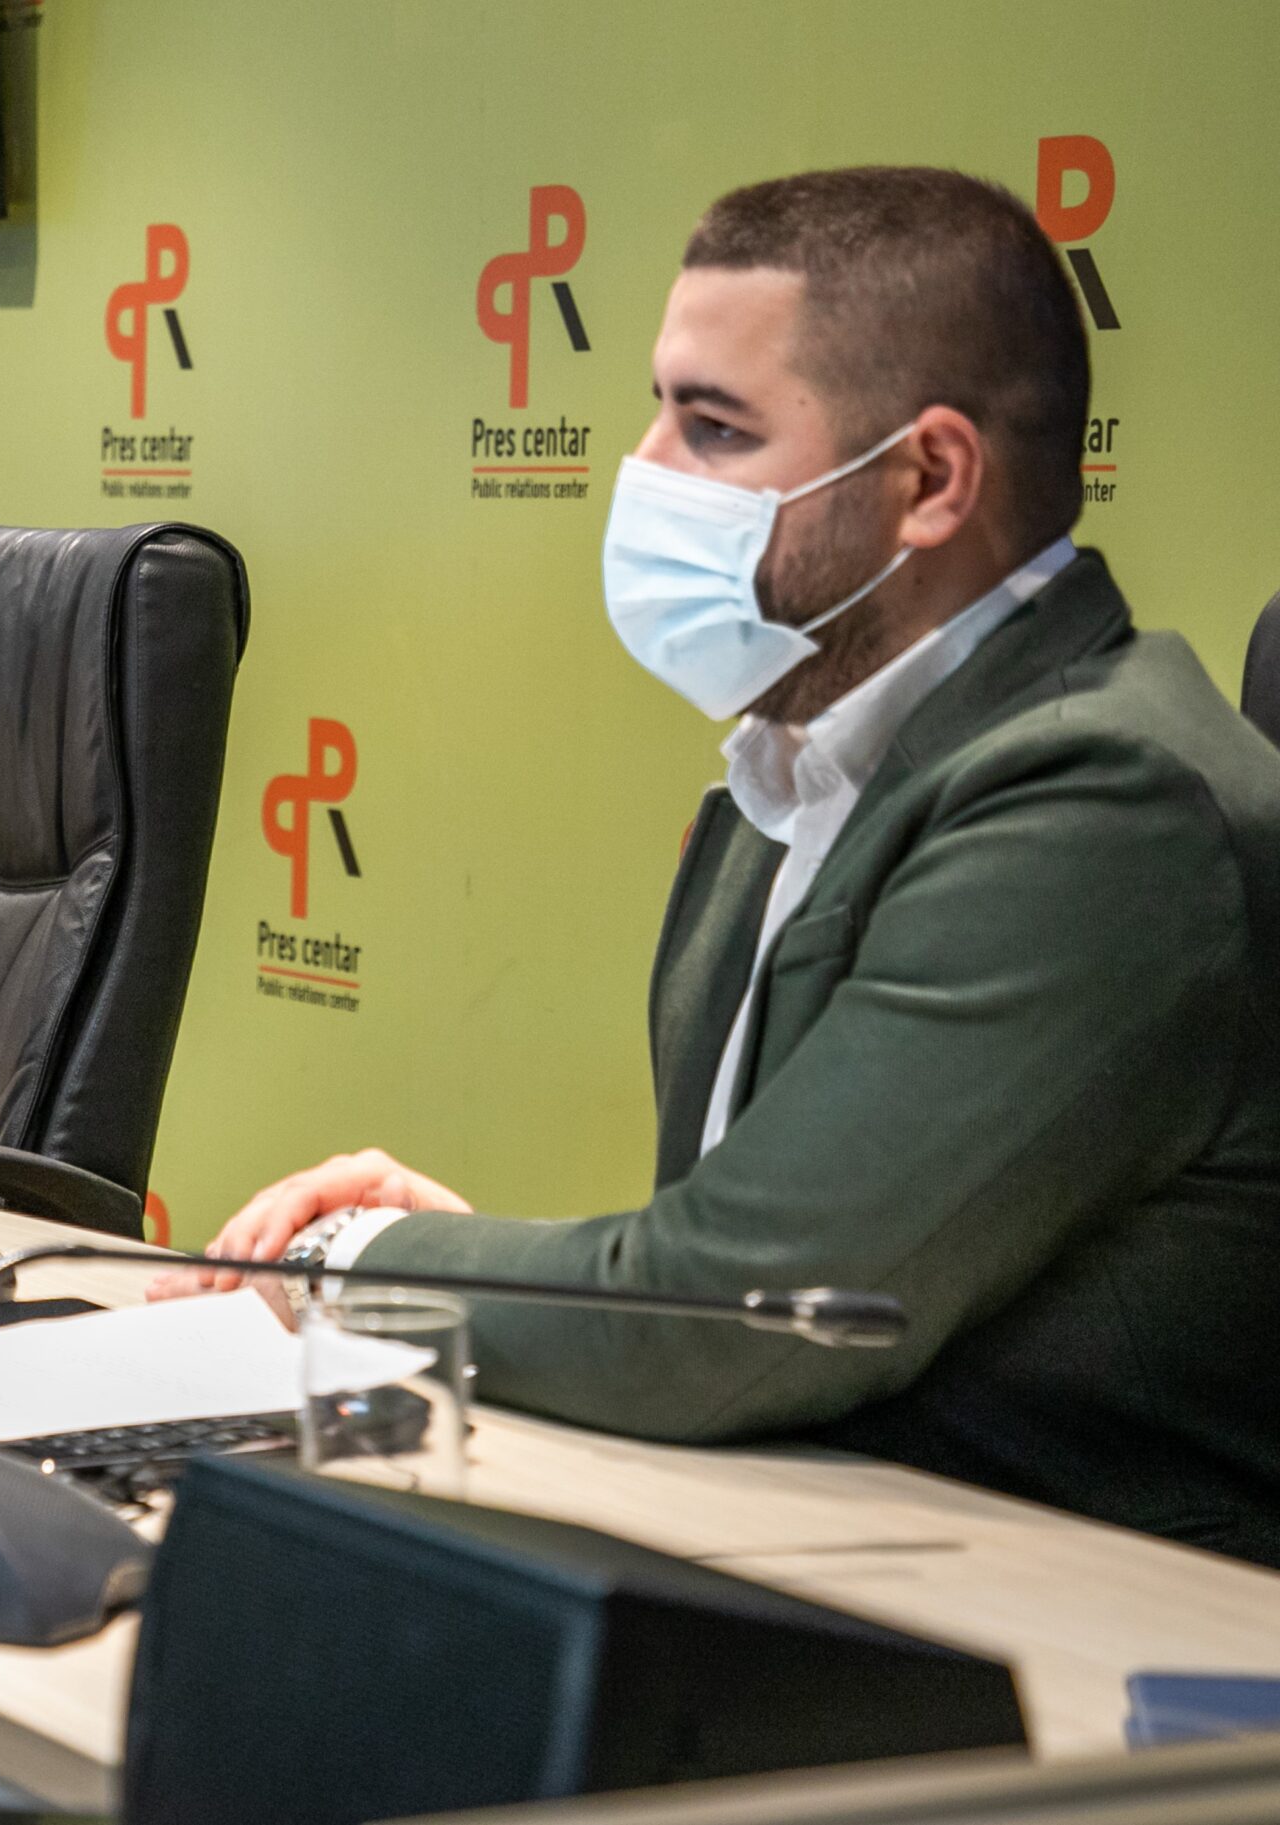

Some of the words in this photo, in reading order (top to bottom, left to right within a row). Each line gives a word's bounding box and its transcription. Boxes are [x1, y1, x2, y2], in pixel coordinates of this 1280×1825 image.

[101, 427, 136, 461] Pres
[141, 427, 192, 462] centar
[472, 418, 516, 457] Pres
[522, 416, 591, 457] centar
[472, 478, 502, 499] Public
[505, 478, 551, 499] relations
[554, 478, 589, 499] center
[1082, 478, 1117, 502] nter
[257, 921, 297, 961] Pres
[302, 932, 361, 974] centar
